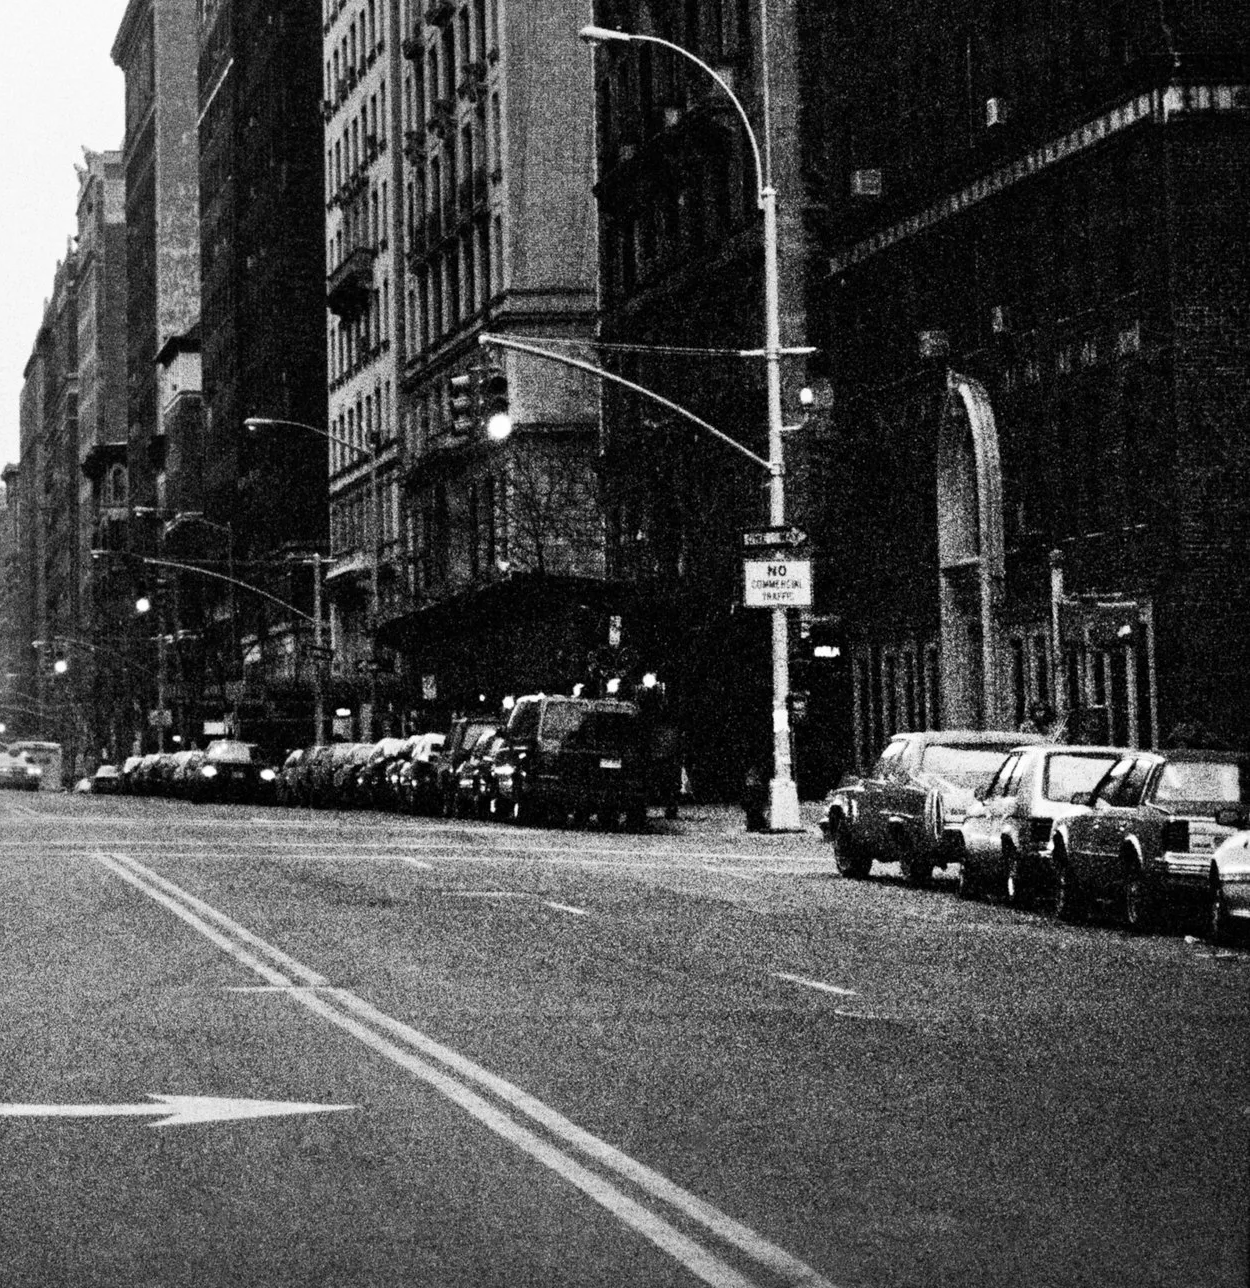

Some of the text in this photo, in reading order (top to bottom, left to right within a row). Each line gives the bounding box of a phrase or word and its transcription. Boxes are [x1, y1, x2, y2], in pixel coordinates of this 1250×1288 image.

[767, 565, 787, 577] NO
[751, 578, 803, 590] COMMERCIAL
[762, 591, 795, 602] TRAFFIC
